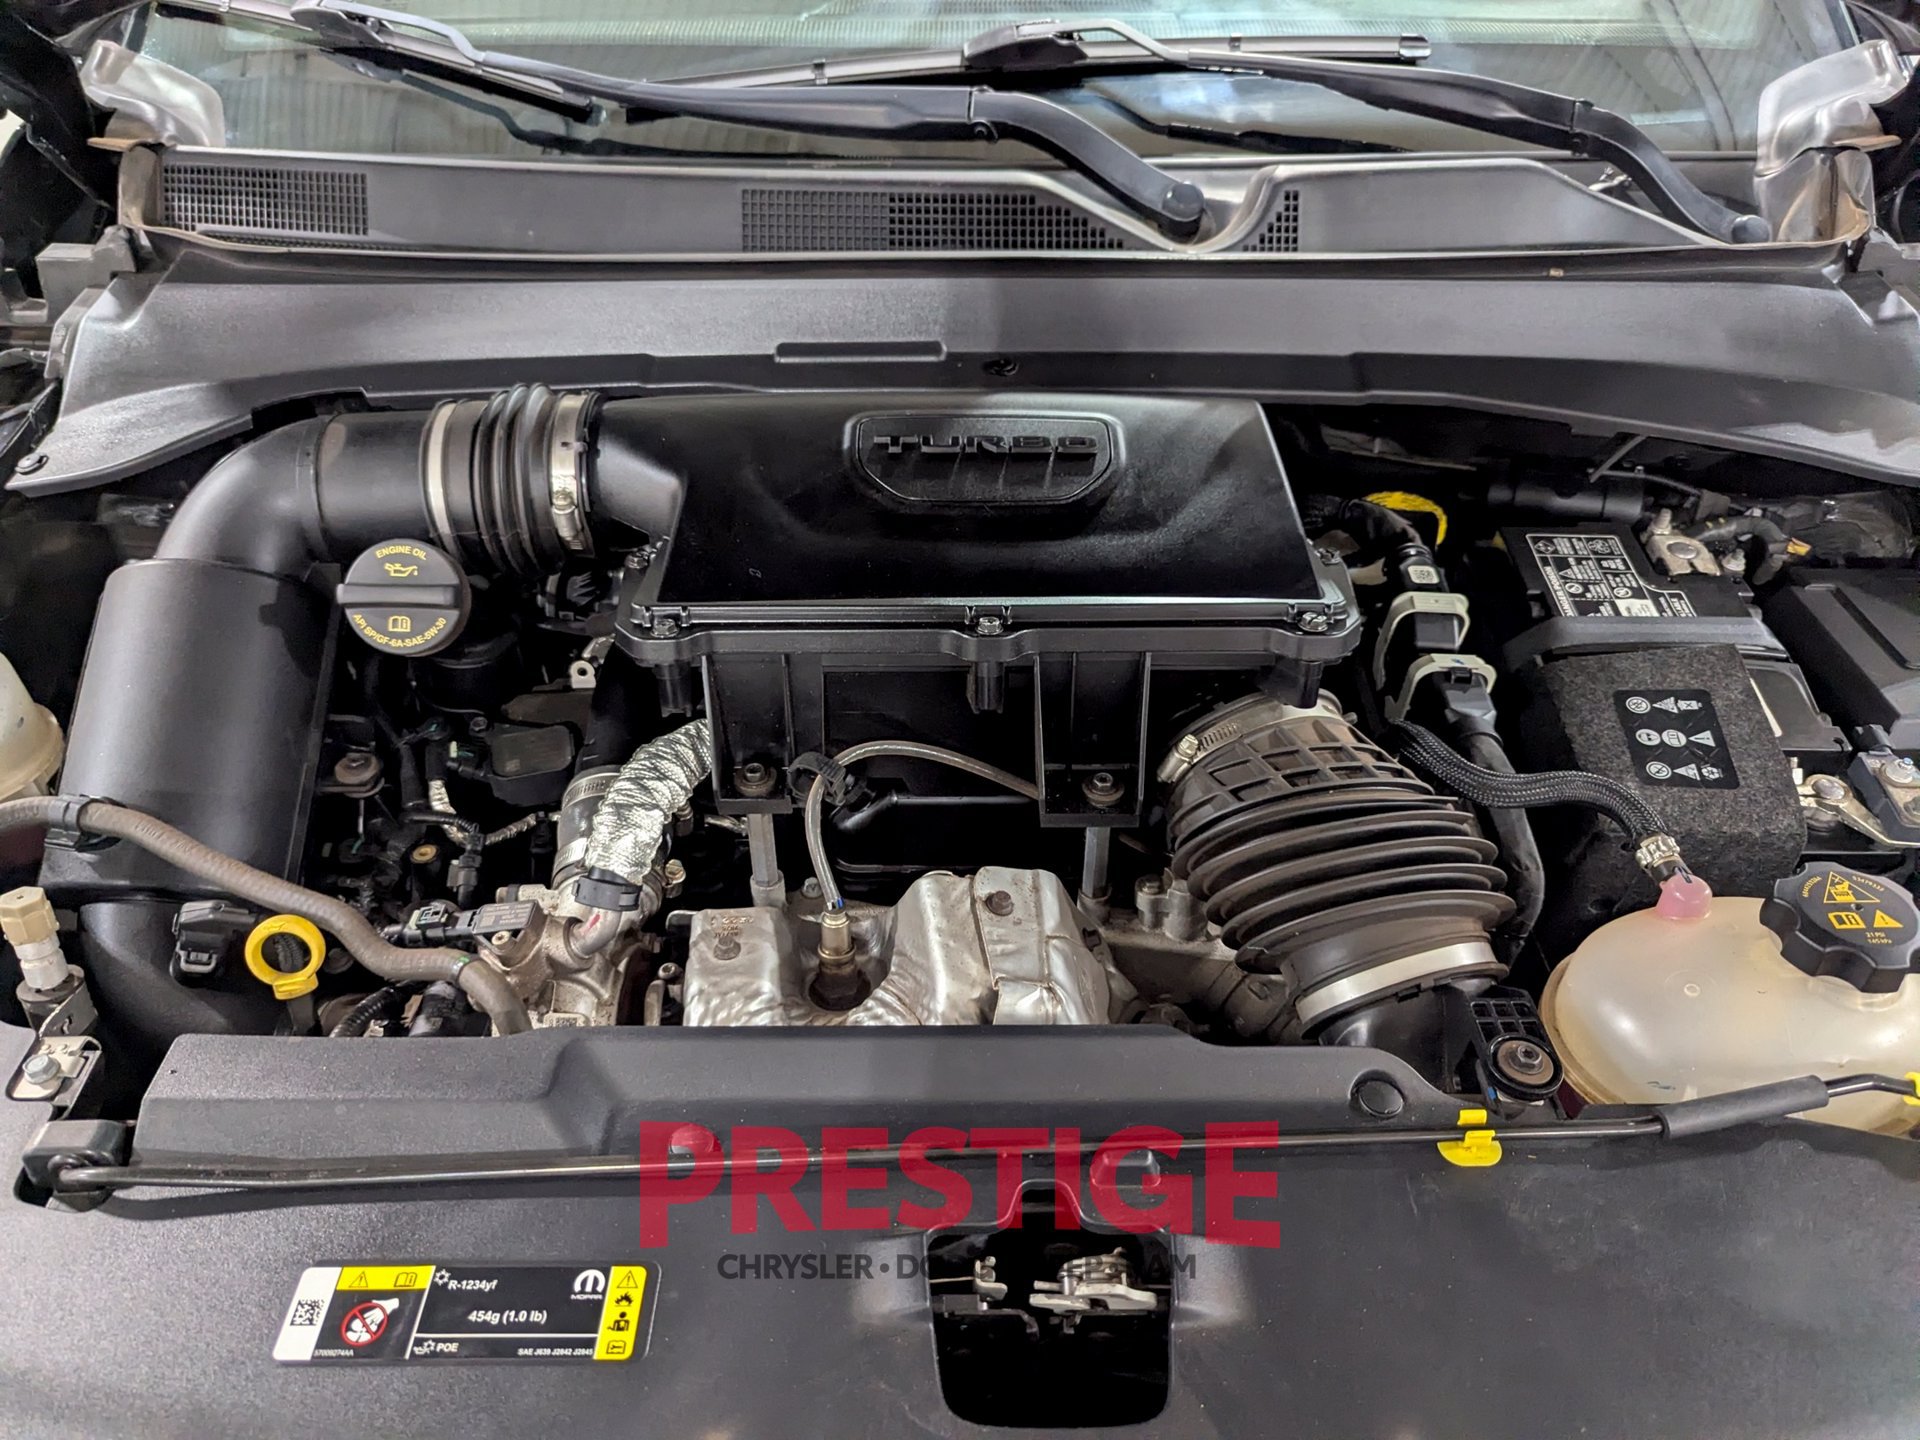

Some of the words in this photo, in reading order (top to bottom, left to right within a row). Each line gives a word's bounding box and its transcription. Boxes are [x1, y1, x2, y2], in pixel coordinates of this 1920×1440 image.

[873, 435, 1098, 454] TURBO
[374, 545, 412, 559] ENGINE
[412, 547, 427, 560] OIL
[352, 613, 365, 629] API
[447, 1279, 499, 1292] R-1234yf
[467, 1310, 501, 1325] 454g
[502, 1309, 528, 1325] (1.0
[529, 1309, 548, 1325] lb)
[436, 1342, 459, 1352] POE
[517, 1347, 534, 1356] SAE
